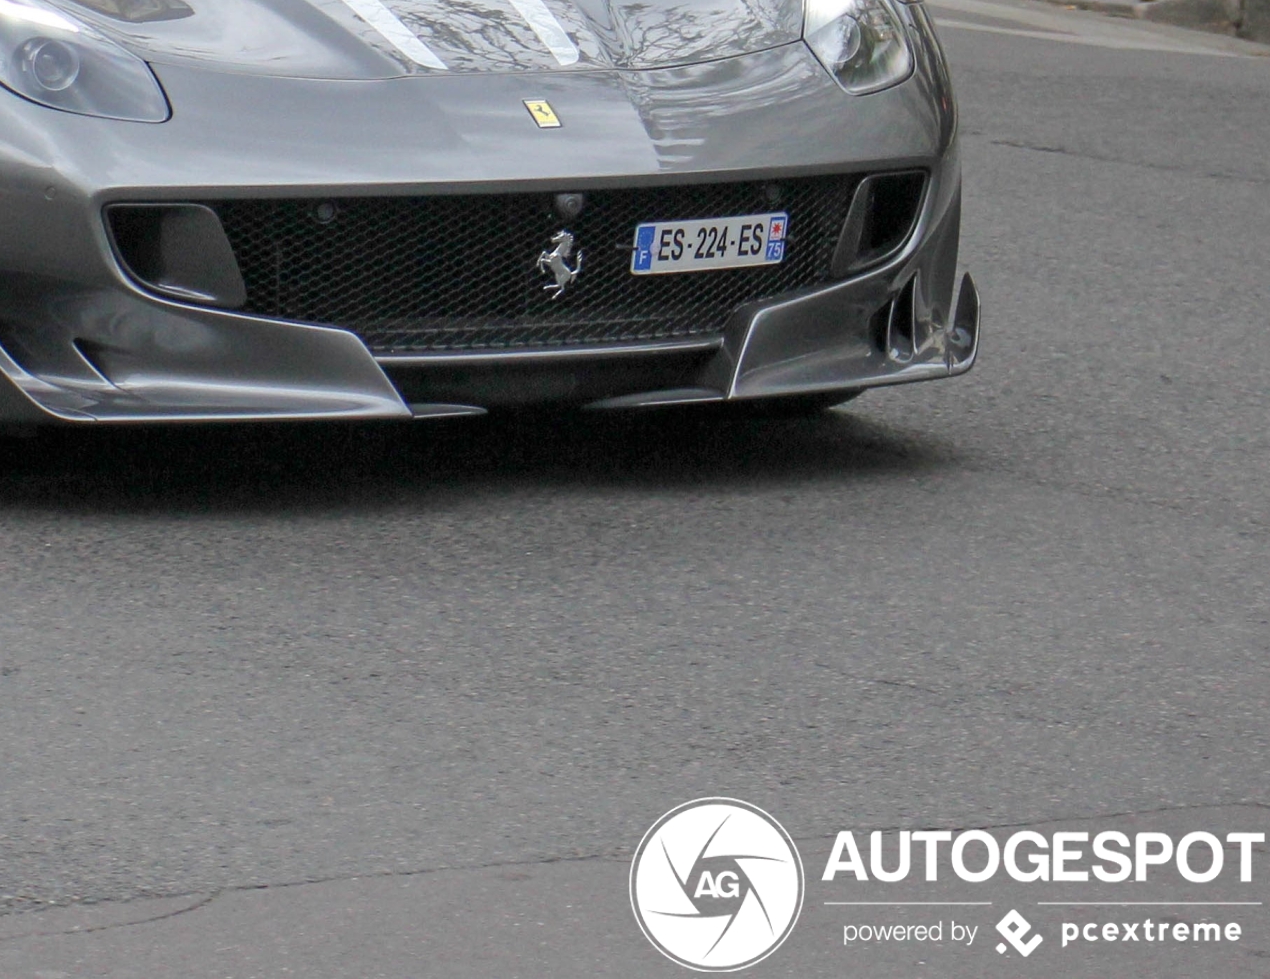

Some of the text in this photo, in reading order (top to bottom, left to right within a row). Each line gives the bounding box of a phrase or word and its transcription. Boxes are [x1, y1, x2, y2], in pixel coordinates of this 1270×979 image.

[638, 223, 782, 265] F ES-224-ES 75
